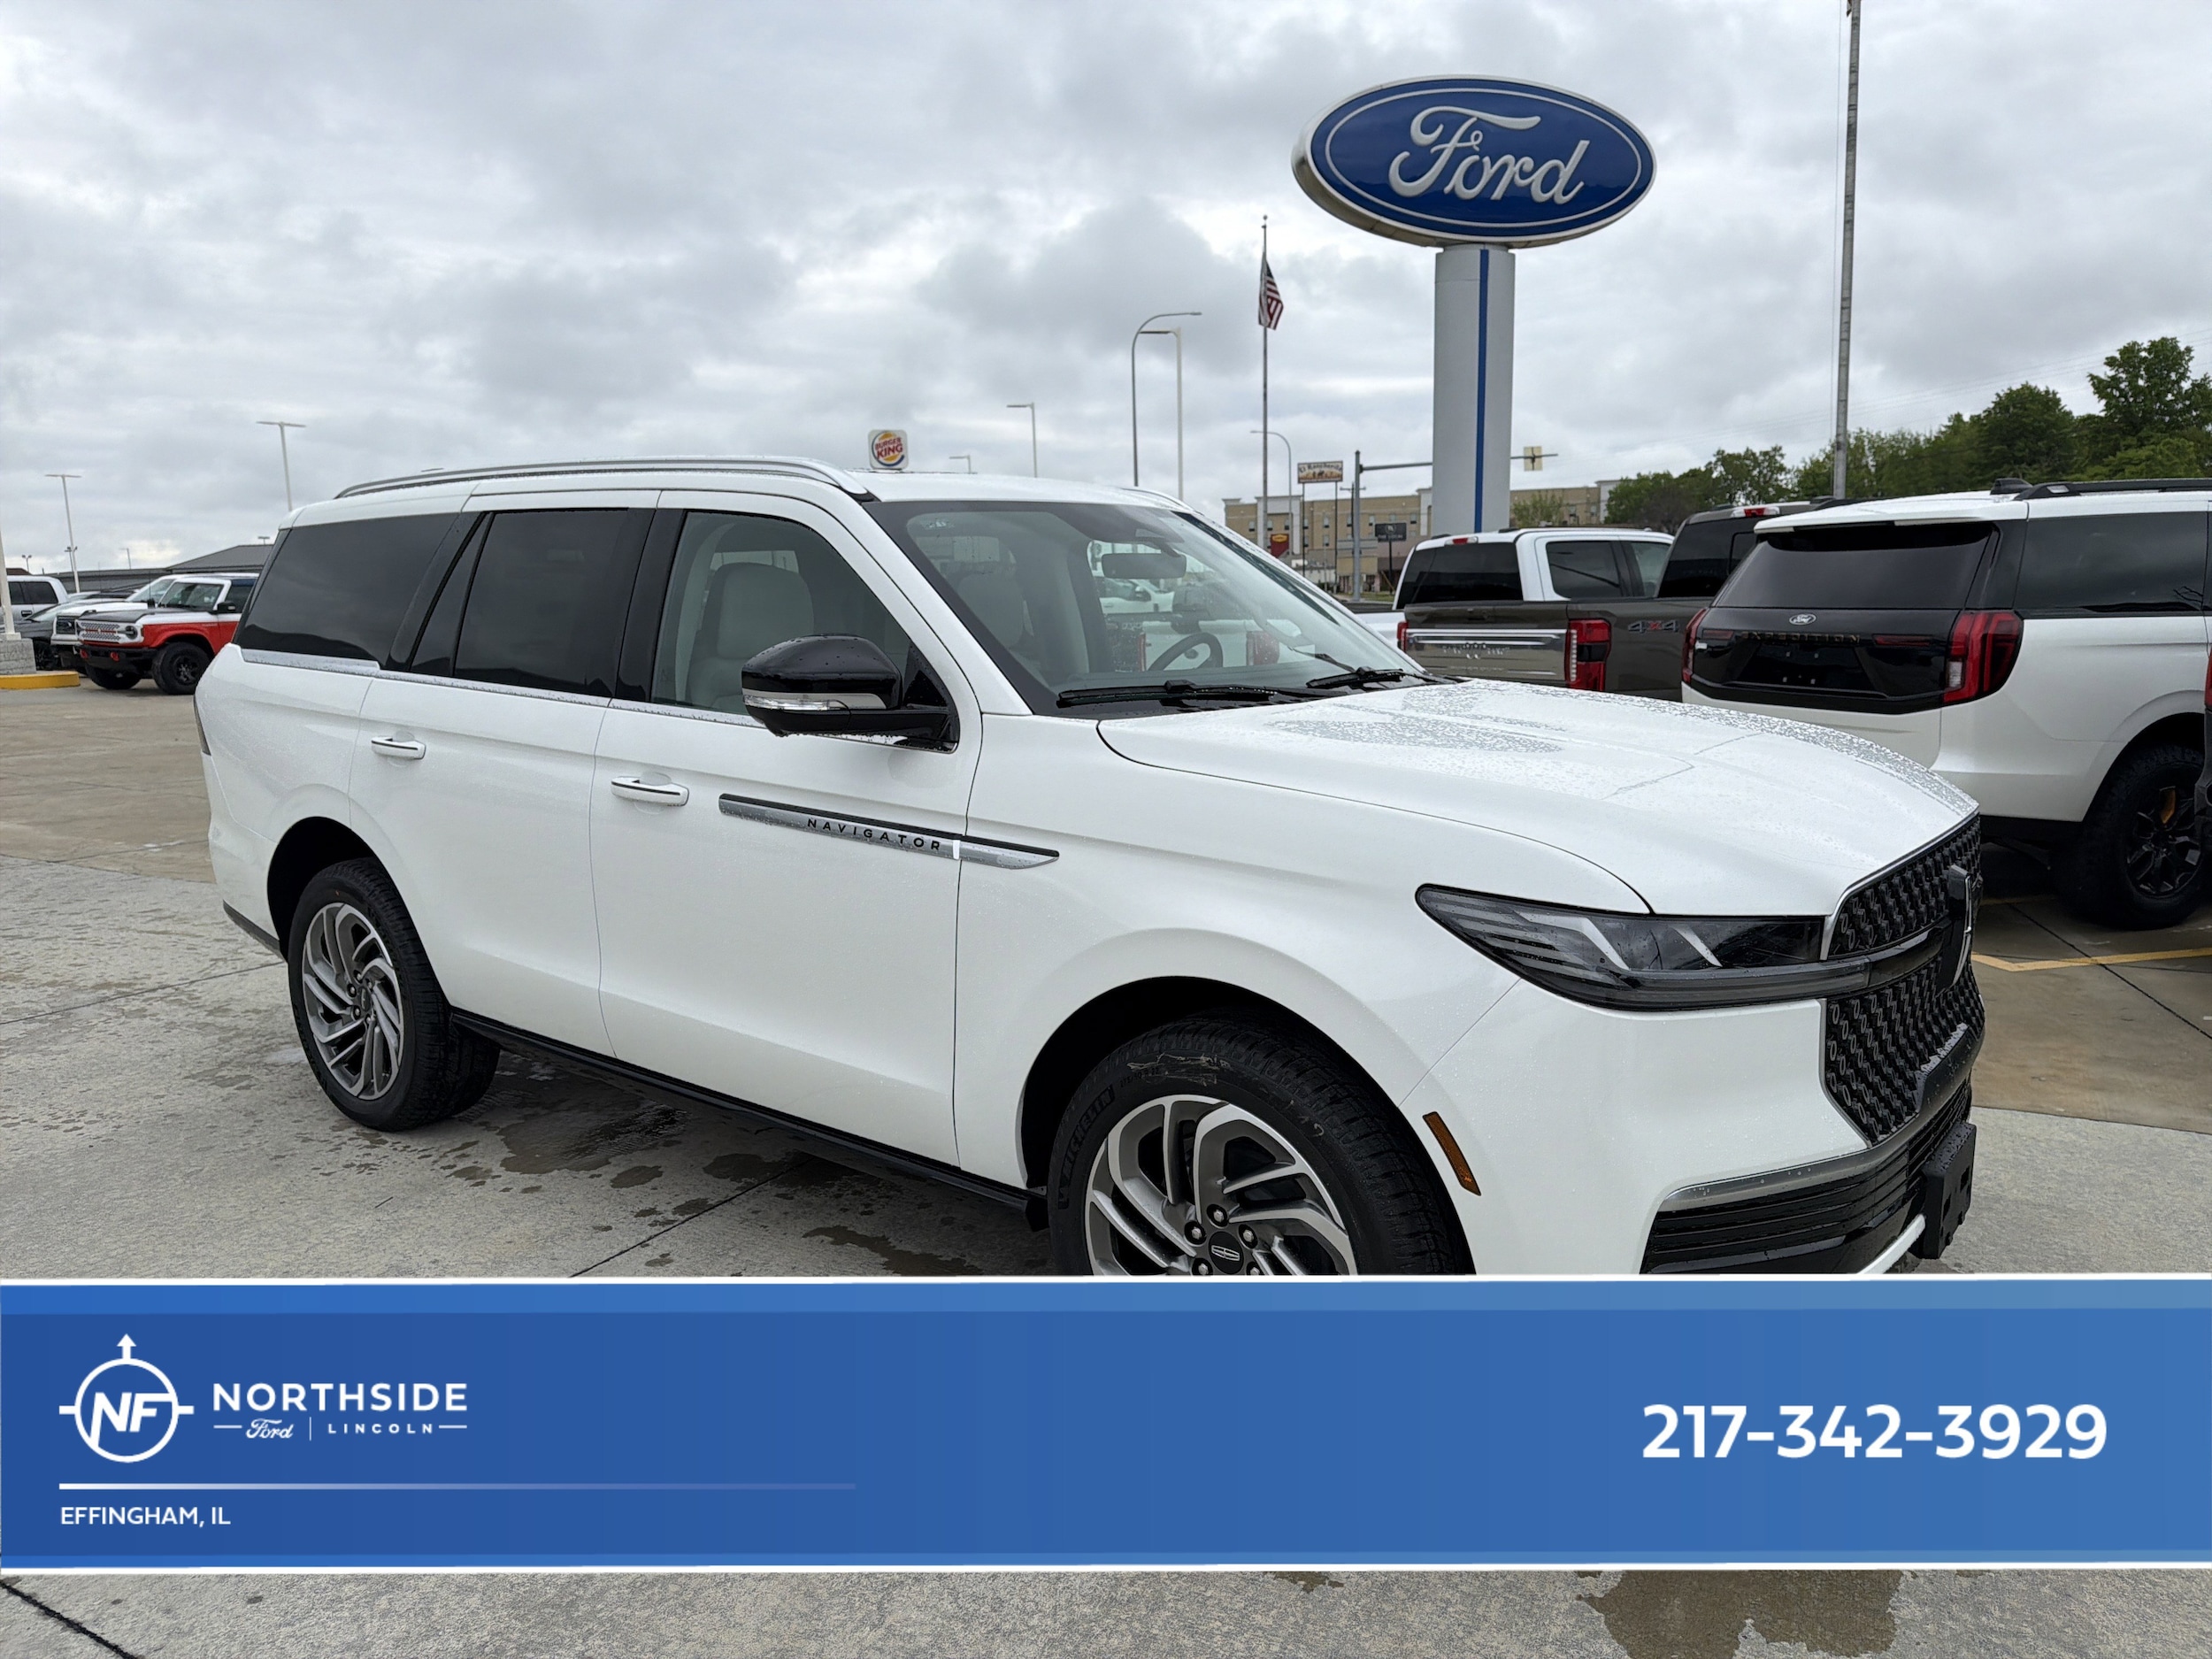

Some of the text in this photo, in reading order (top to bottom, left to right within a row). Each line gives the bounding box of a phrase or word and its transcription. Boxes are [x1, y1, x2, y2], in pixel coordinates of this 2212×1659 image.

[1388, 104, 1591, 205] Ford
[874, 436, 902, 450] BURGER
[877, 443, 902, 459] KING
[1740, 630, 1860, 644] EXPEDITION
[807, 818, 941, 851] NAVIGATOR
